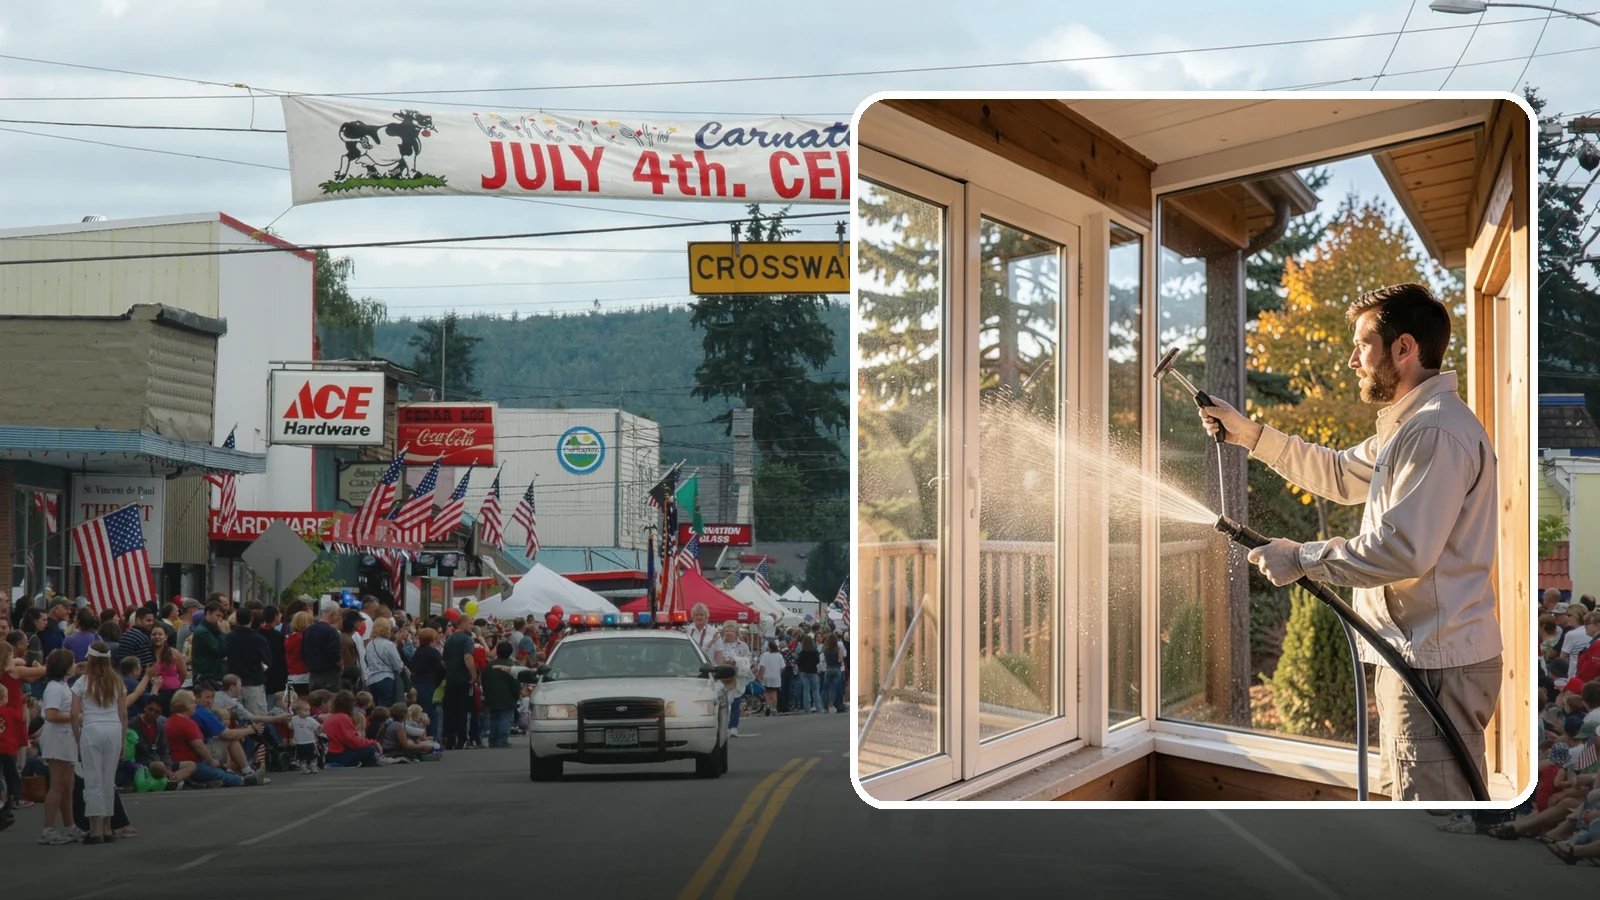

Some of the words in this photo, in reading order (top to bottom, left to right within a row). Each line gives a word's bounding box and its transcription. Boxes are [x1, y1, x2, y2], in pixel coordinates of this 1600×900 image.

[481, 141, 605, 192] JULY
[632, 150, 746, 198] 4th.
[697, 254, 850, 280] CROSSWA
[283, 380, 373, 420] ACE
[405, 409, 453, 422] CEDAR
[461, 409, 485, 422] LOG
[283, 421, 371, 437] Hardware
[416, 428, 477, 447] Coca-Cola
[353, 467, 384, 479] Simpl
[83, 486, 94, 495] St.
[96, 485, 124, 495] Vincent
[126, 486, 136, 495] de
[138, 486, 155, 496] Paul
[688, 527, 741, 535] CRNATION
[699, 535, 730, 543] GLASS
